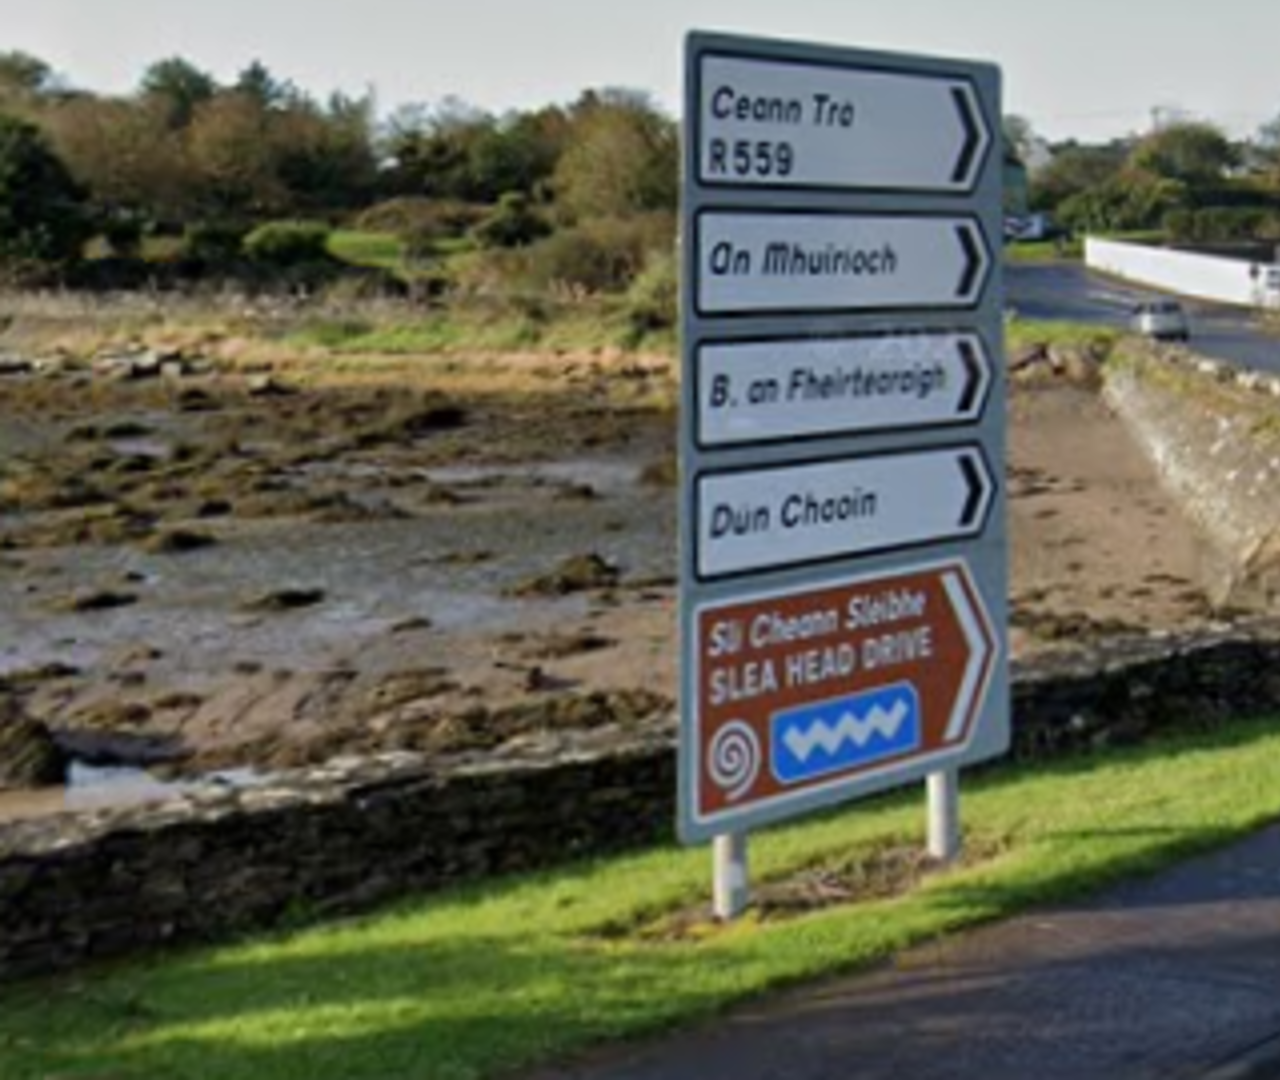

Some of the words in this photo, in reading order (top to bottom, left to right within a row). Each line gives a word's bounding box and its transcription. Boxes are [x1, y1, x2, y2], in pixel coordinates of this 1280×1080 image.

[711, 84, 803, 123] Ceann
[708, 137, 795, 176] R559
[748, 377, 779, 405] an
[709, 660, 778, 706] SLEA
[786, 643, 854, 688] HEAD
[862, 626, 933, 669] DRIVE
